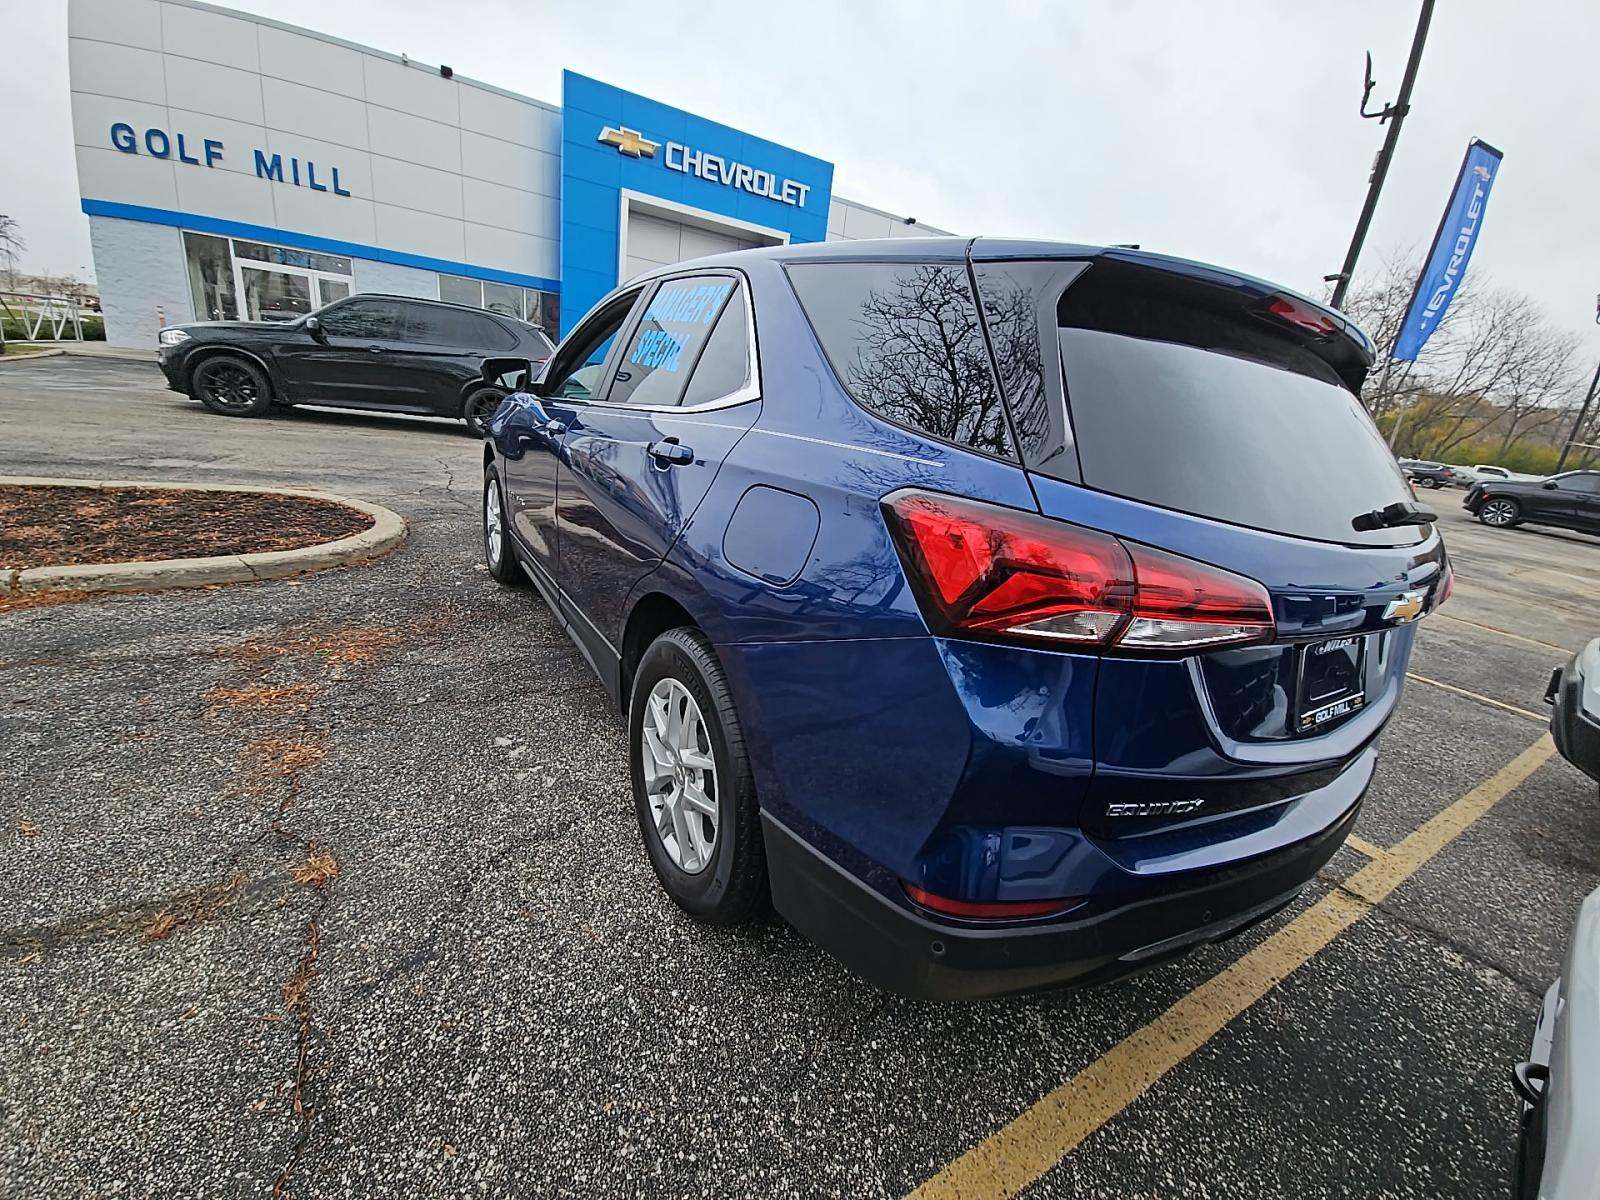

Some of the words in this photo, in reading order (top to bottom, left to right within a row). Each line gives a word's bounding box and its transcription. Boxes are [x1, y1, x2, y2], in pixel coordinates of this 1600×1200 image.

[110, 122, 224, 168] GOLF
[254, 150, 351, 197] MILL
[664, 141, 811, 208] CHEVROLET
[1420, 182, 1483, 330] HEVROLET
